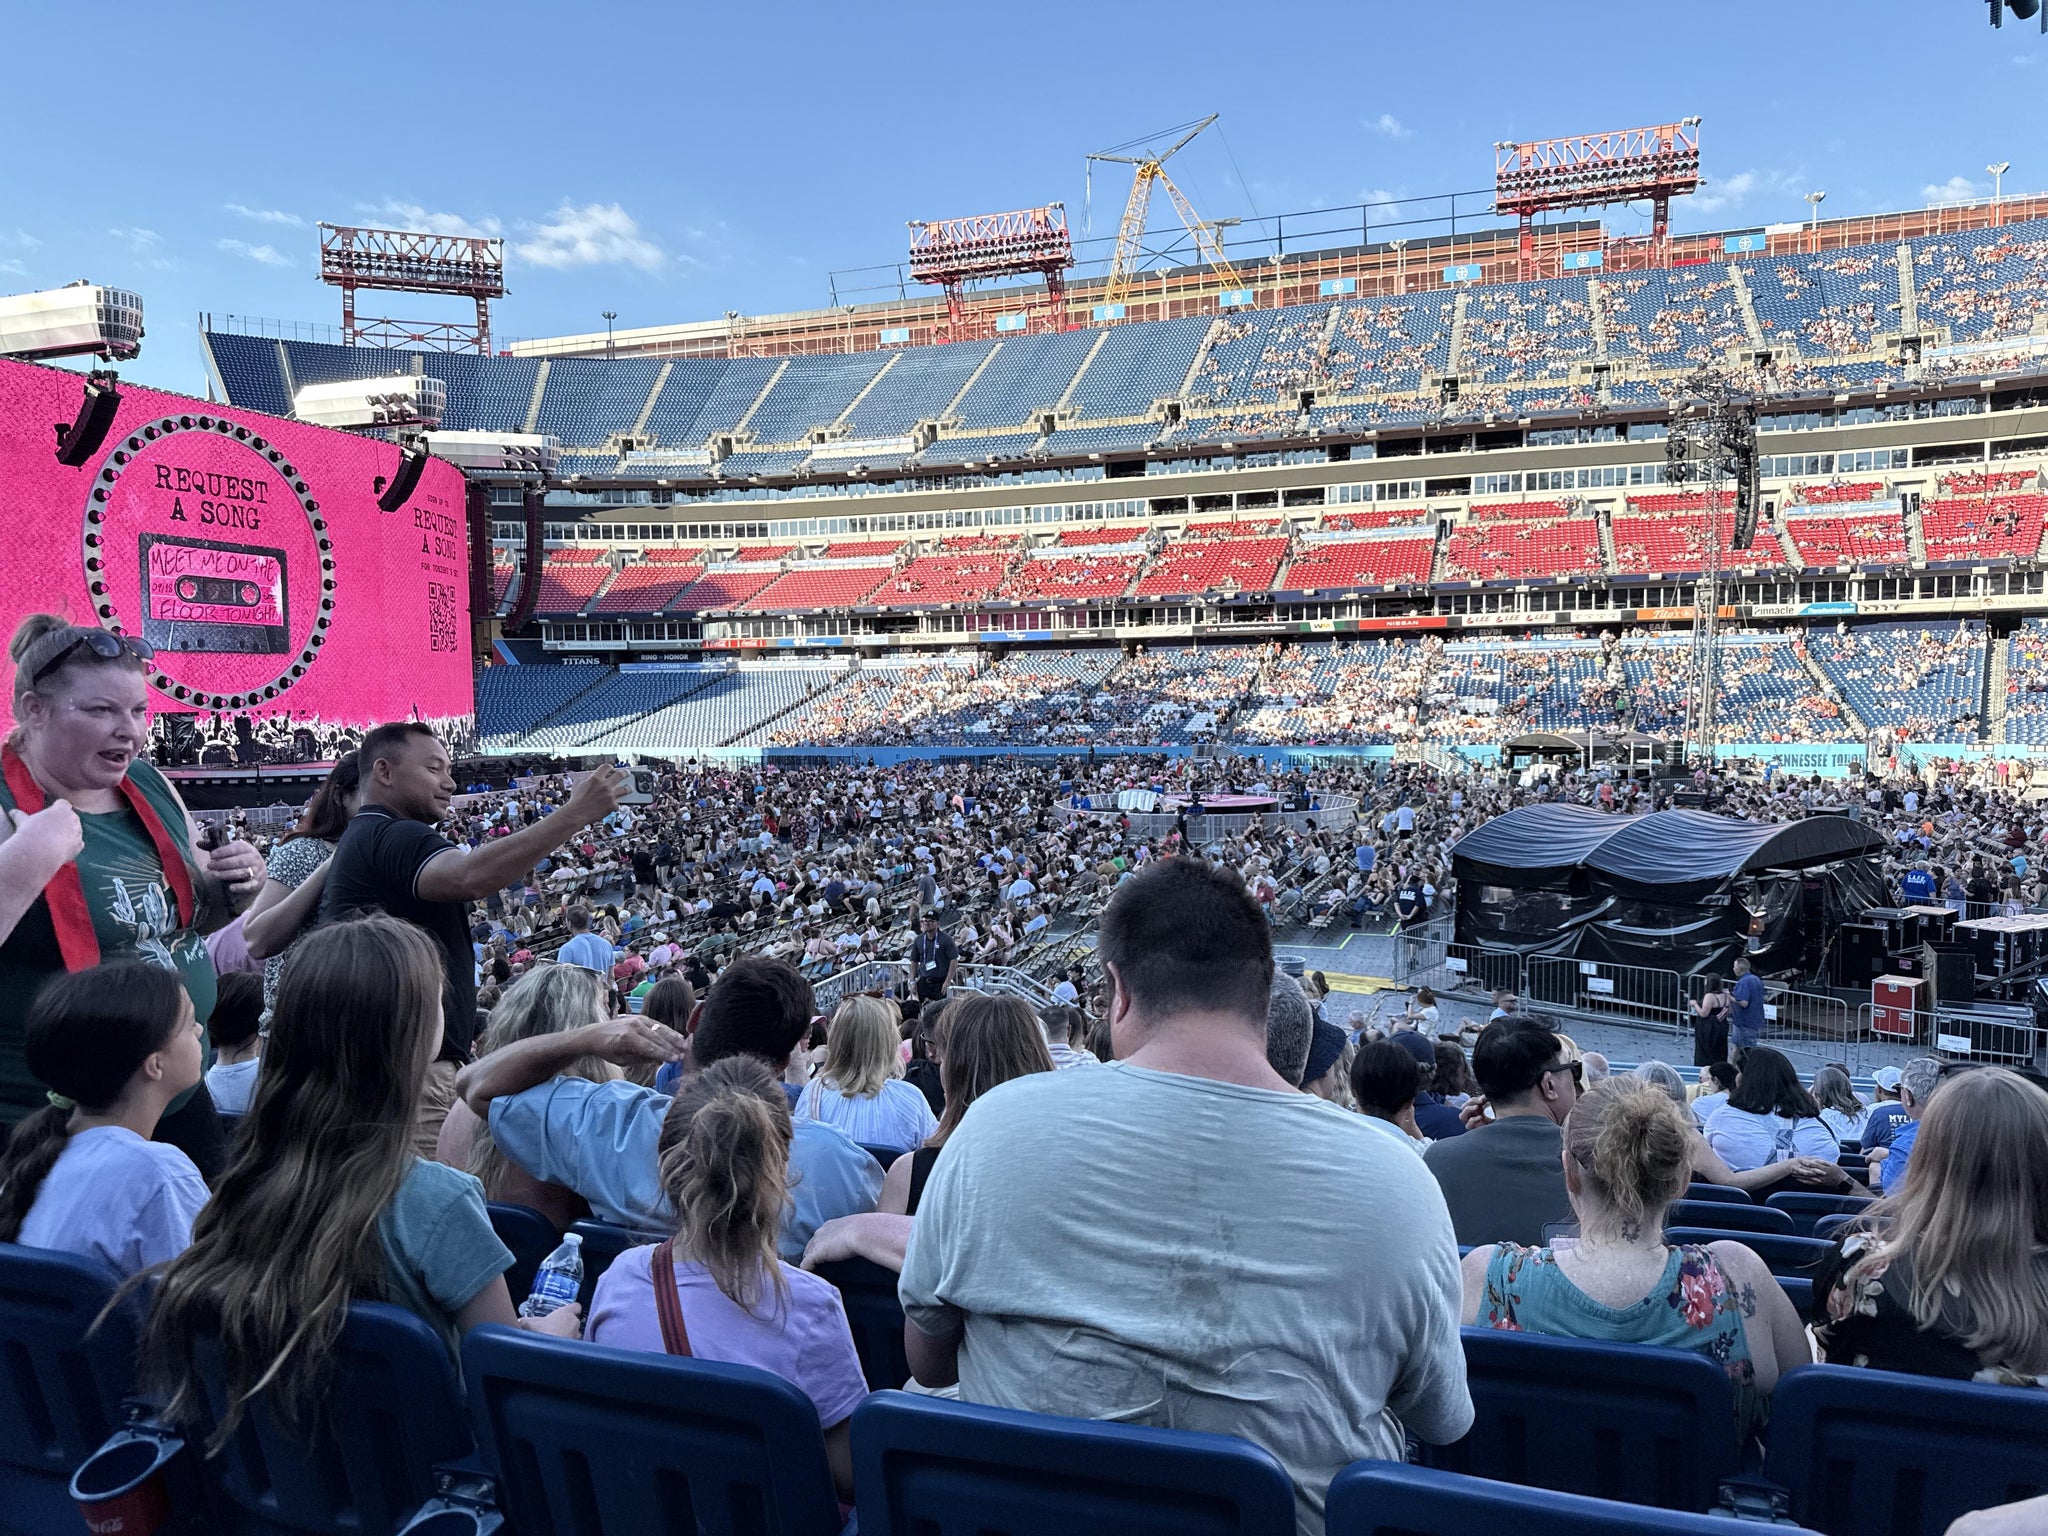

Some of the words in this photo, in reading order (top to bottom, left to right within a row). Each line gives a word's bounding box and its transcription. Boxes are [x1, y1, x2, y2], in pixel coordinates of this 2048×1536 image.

[155, 464, 268, 504] REQUEST
[169, 496, 188, 521] A
[200, 500, 261, 530] SONG
[413, 507, 458, 539] REQUEST
[421, 533, 430, 554] A
[435, 536, 456, 561] SONG
[152, 547, 197, 576] MEET
[201, 551, 223, 573] ME
[227, 554, 249, 573] ON
[160, 599, 218, 620] FLOOR
[222, 607, 279, 622] TONIGHT
[1653, 607, 1680, 618] Tito's
[1755, 605, 1794, 614] Pinnacle
[562, 657, 600, 665] TITANS
[1777, 754, 1828, 767] ENNESSEE
